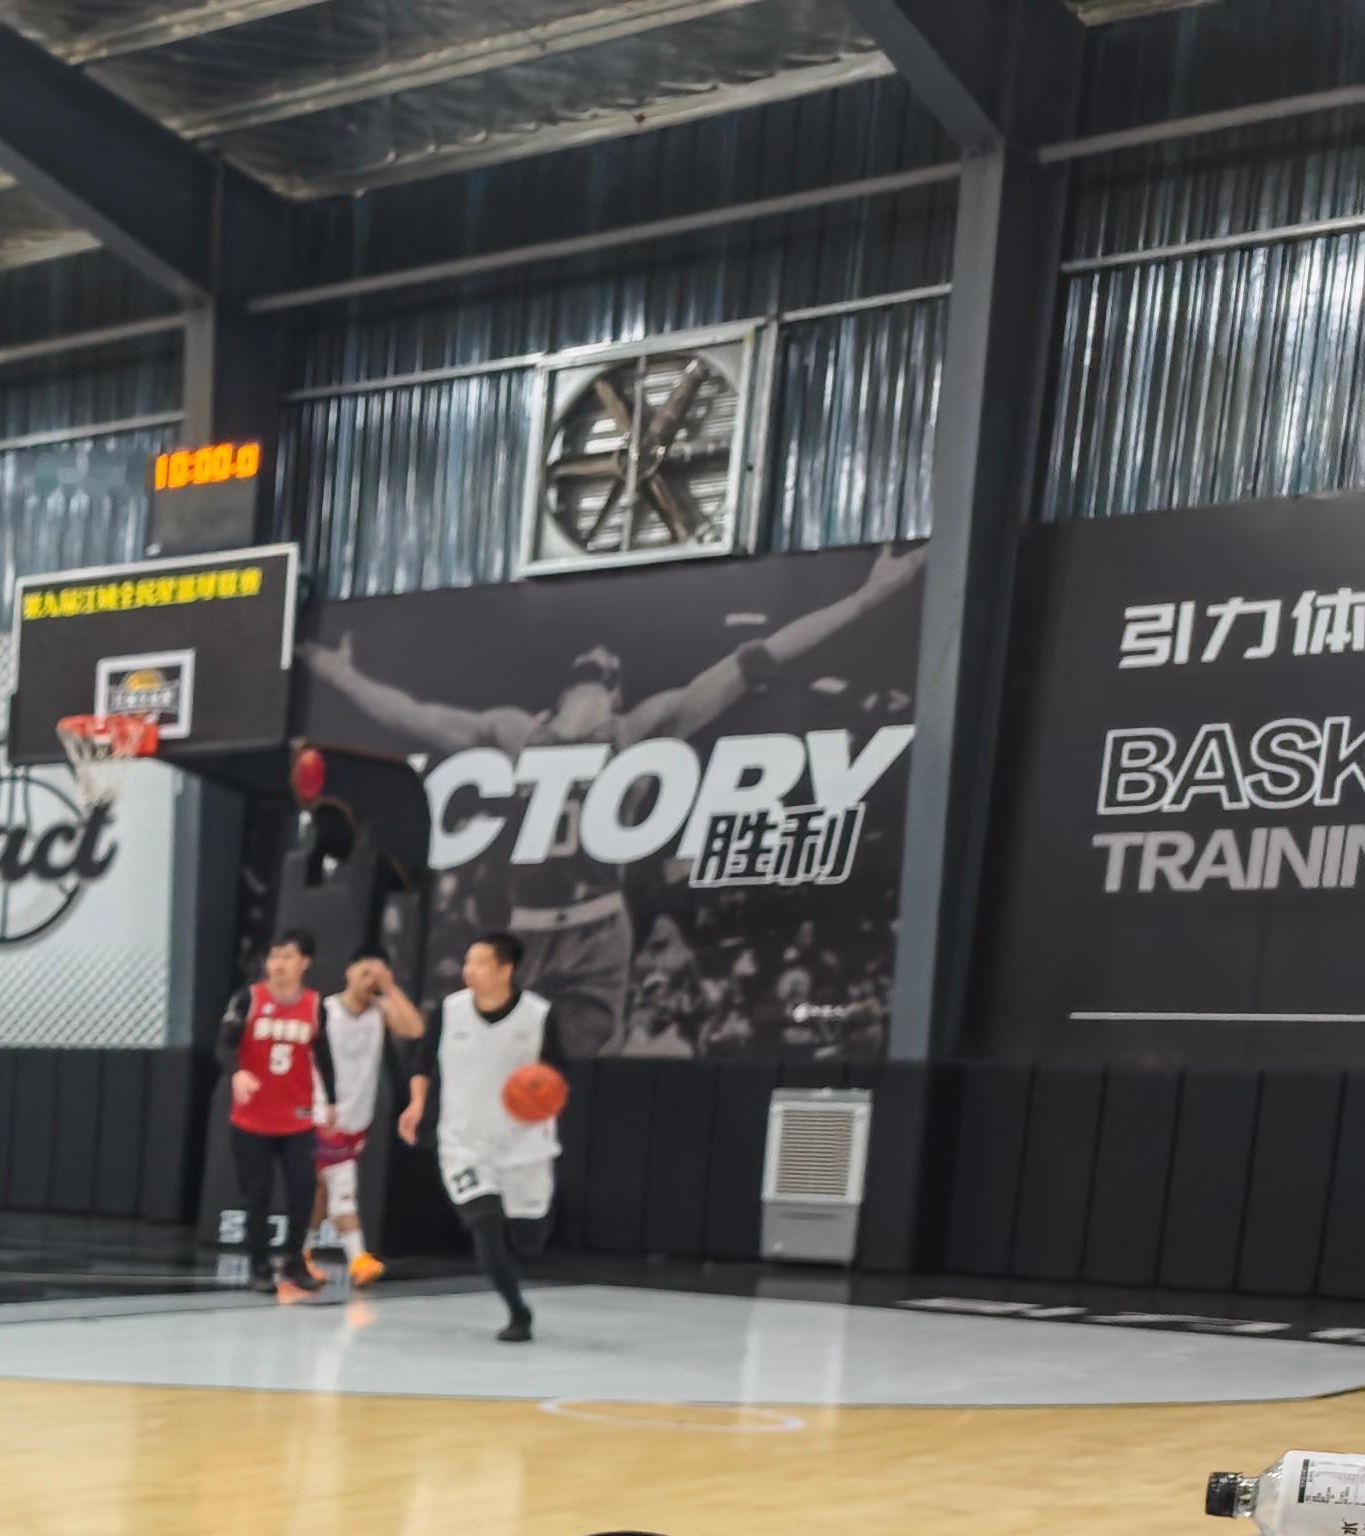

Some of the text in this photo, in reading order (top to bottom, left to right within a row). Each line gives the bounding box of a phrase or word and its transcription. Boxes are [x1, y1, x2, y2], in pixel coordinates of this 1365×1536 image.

[1116, 587, 1365, 669] 引力体
[412, 723, 917, 871] CTORY
[689, 802, 866, 888] 胜利
